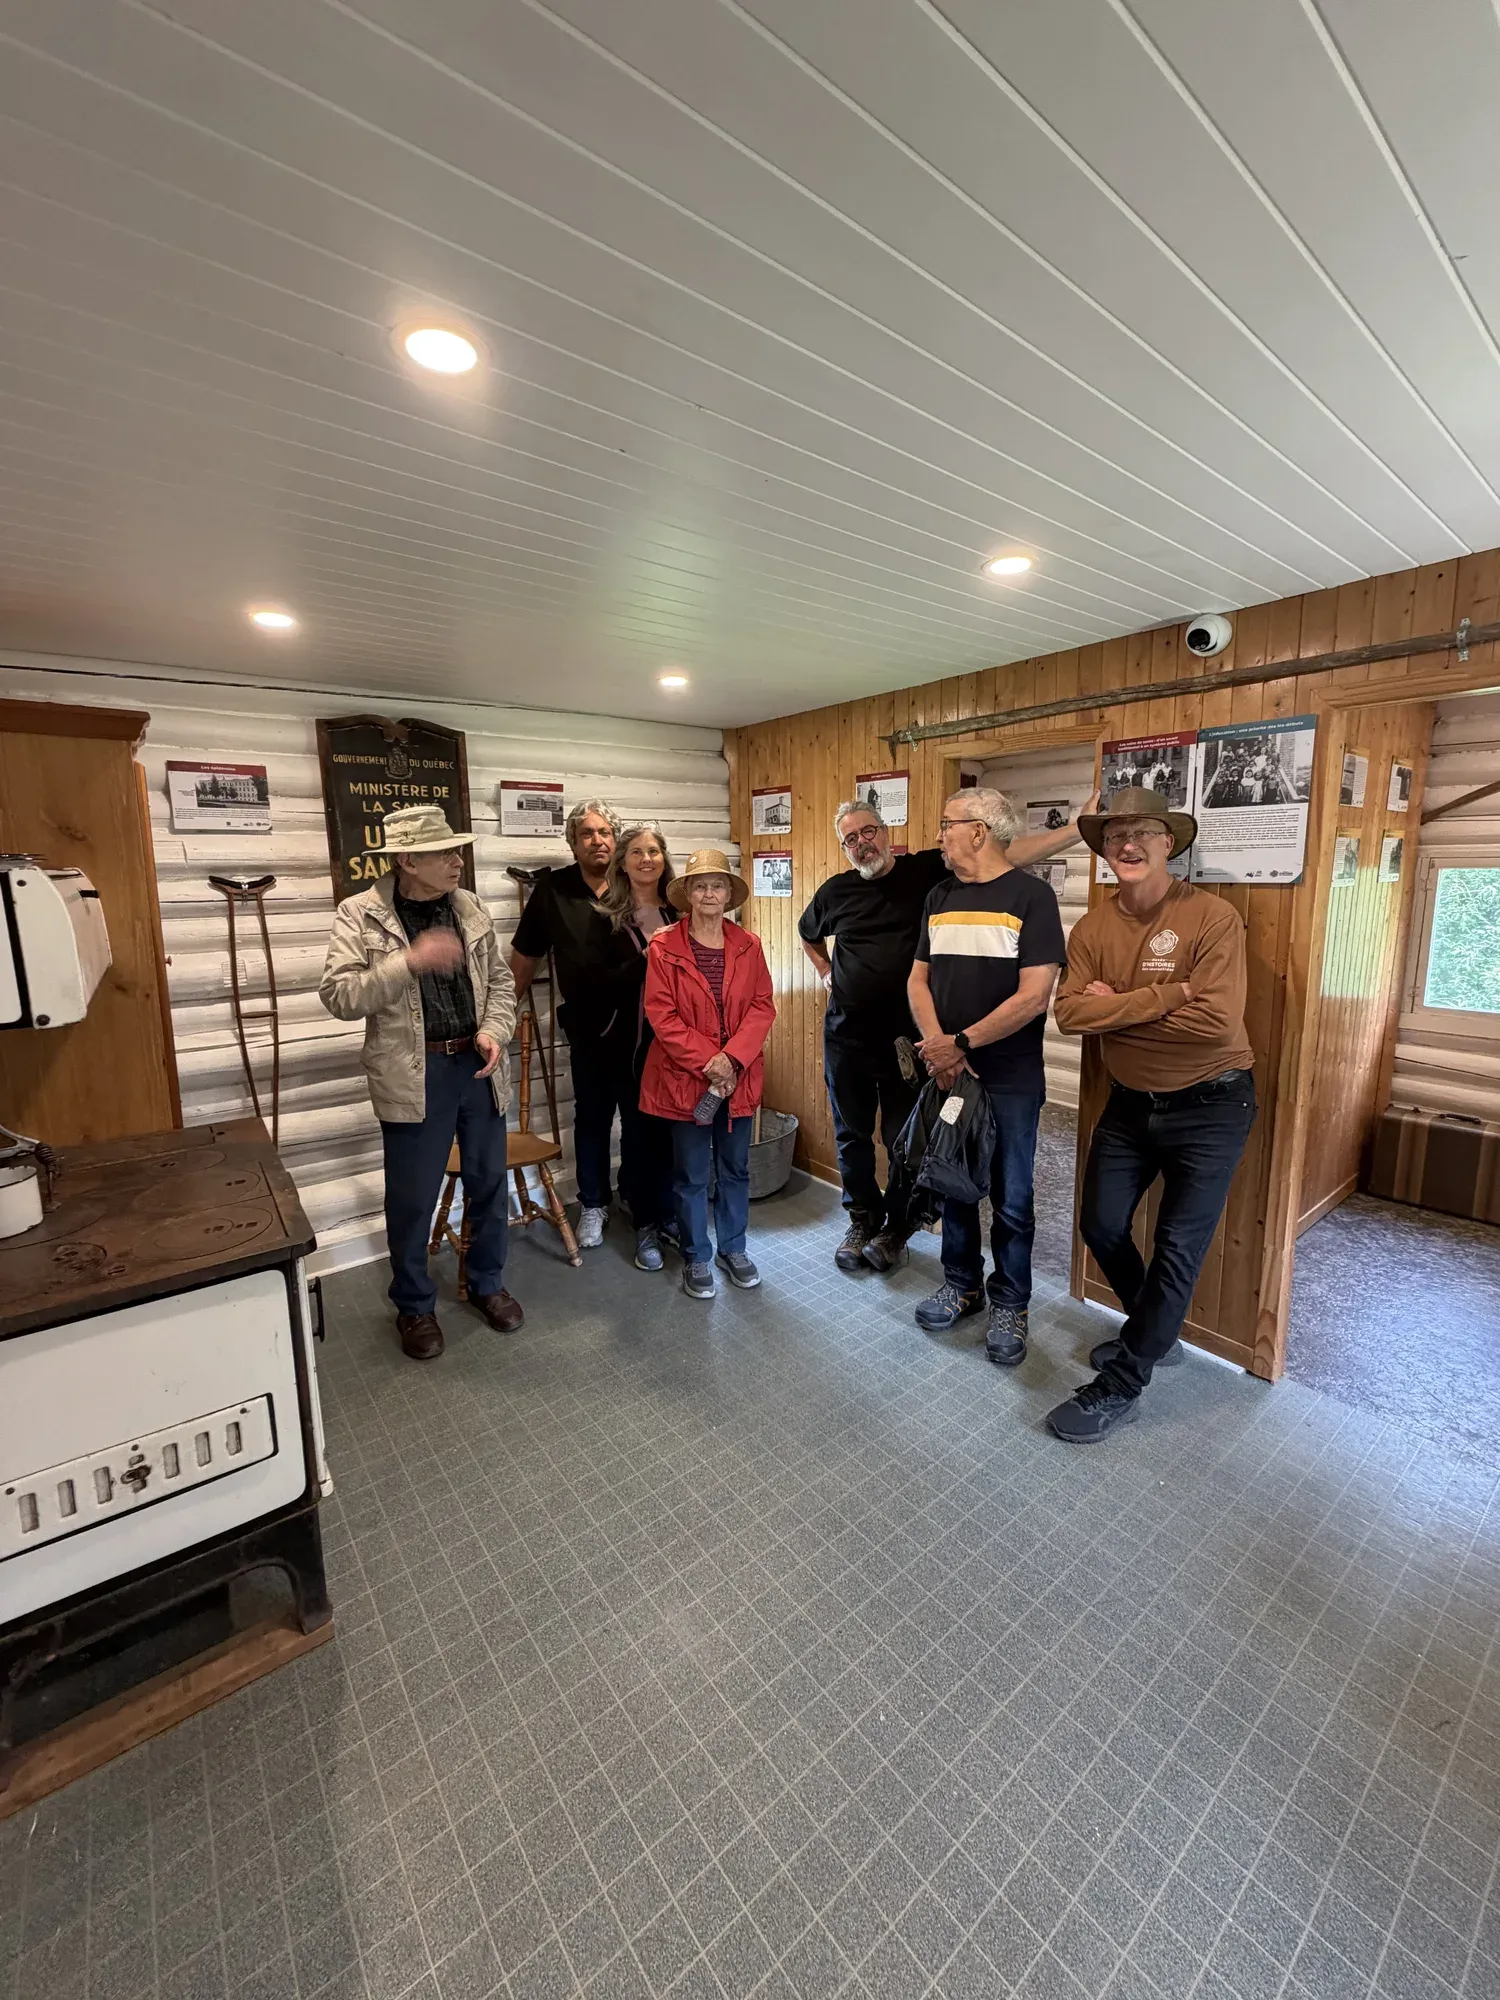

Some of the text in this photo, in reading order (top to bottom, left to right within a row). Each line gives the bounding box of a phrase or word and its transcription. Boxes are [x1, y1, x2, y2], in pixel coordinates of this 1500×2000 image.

[333, 754, 454, 770] GOUVERNEMENT DU QUÉBEC
[350, 782, 450, 798] MINISTÈRE DE
[362, 801, 385, 813] LA
